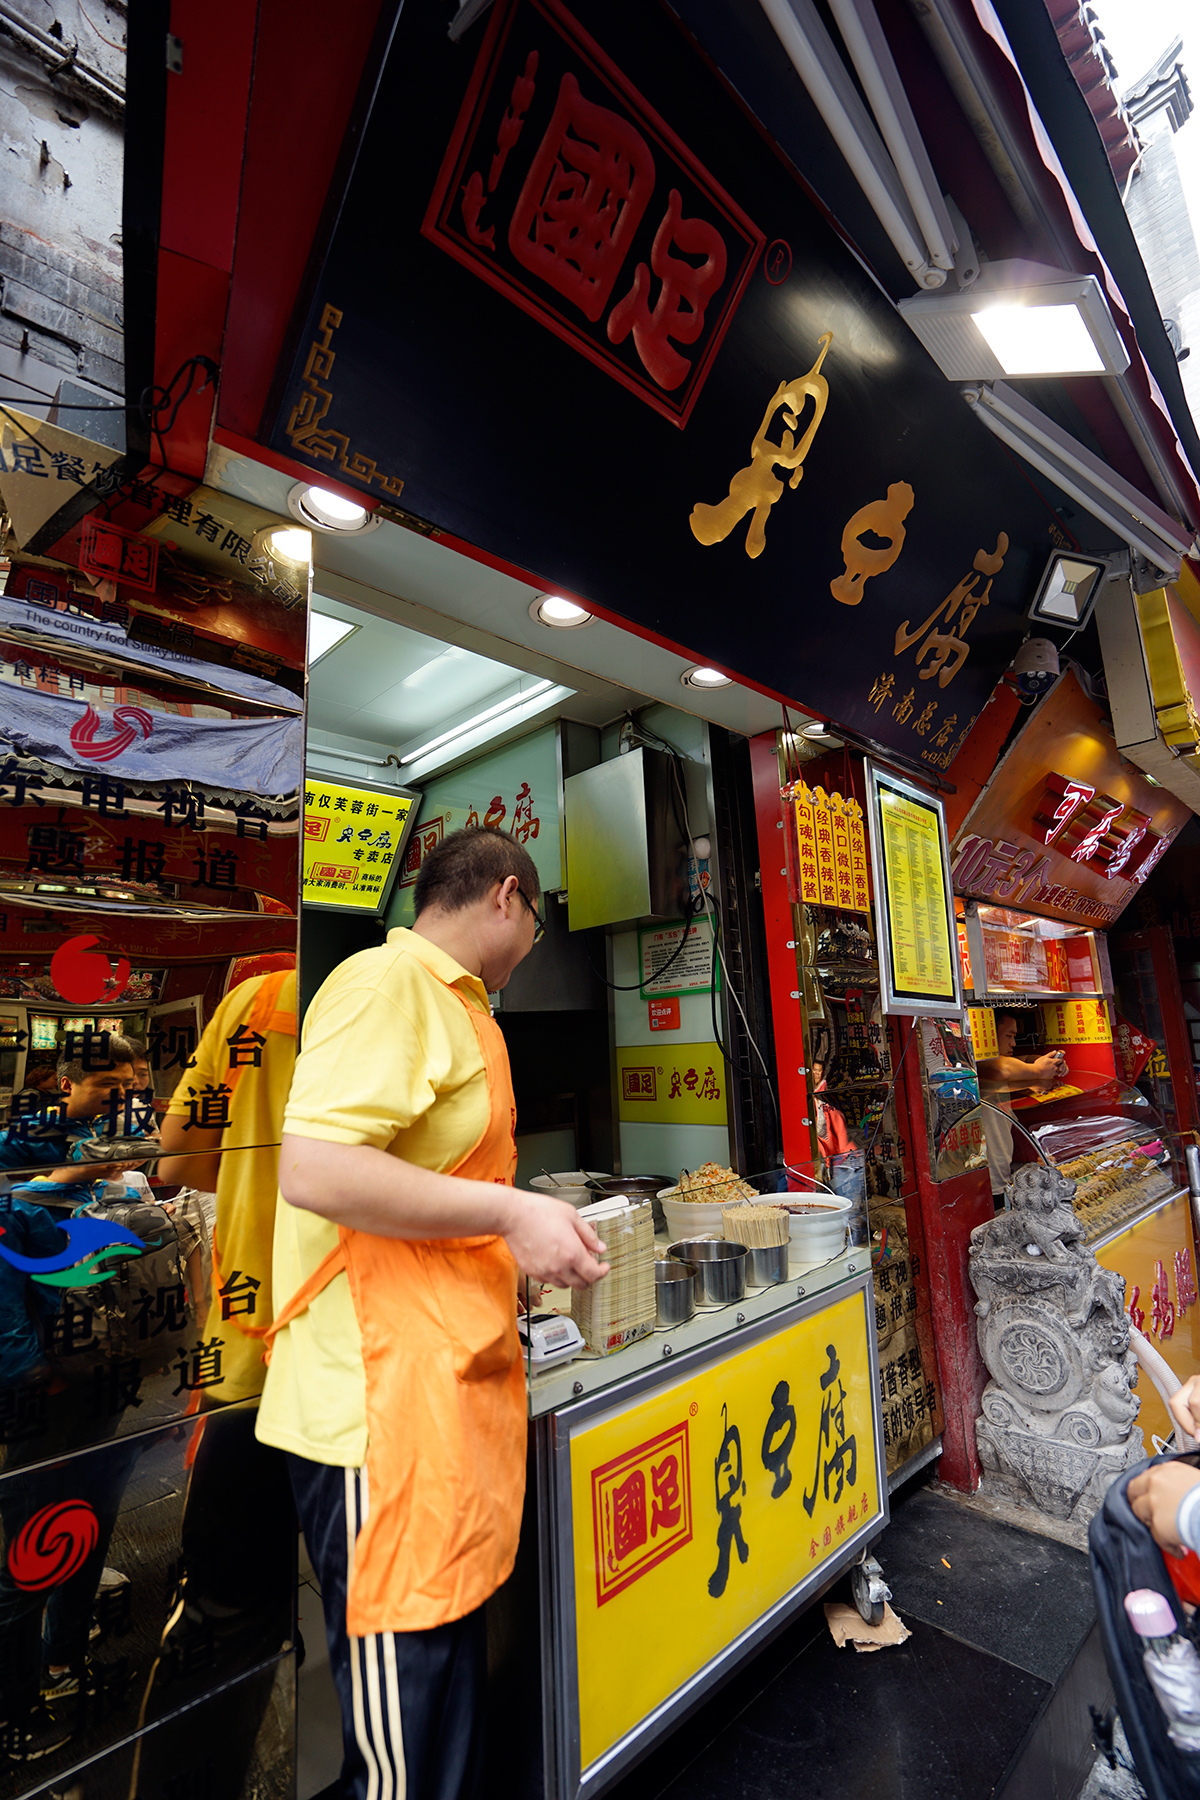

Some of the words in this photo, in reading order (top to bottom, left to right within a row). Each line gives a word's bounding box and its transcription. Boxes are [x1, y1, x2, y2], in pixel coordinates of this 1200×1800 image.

[0, 442, 303, 610] 足餐饮管理有限公司
[689, 331, 1010, 689] 臭豆腐
[25, 609, 50, 626] The
[53, 617, 107, 642] country
[106, 630, 129, 647] foot
[132, 640, 170, 660] Stinky
[26, 578, 195, 649] 国足臭豆腐
[0, 659, 85, 691] 食栏目
[25, 826, 239, 892] 题报道
[336, 825, 392, 849] 臭豆腐
[353, 849, 394, 864] 专卖店
[799, 804, 817, 899] 勾魂麻辣酱
[816, 811, 836, 902] 经典香辣酱
[834, 815, 853, 905] 爽口微辣酱
[850, 820, 868, 908] 传统五香酱
[952, 833, 1052, 904] 10元3个
[6, 1082, 233, 1147] 题报道
[668, 1066, 721, 1100] 臭豆腐
[940, 1122, 982, 1153] A级单位
[44, 1271, 260, 1358] 电视台
[707, 1343, 857, 1599] 臭豆腐
[808, 1492, 870, 1559] 全国旗舰店
